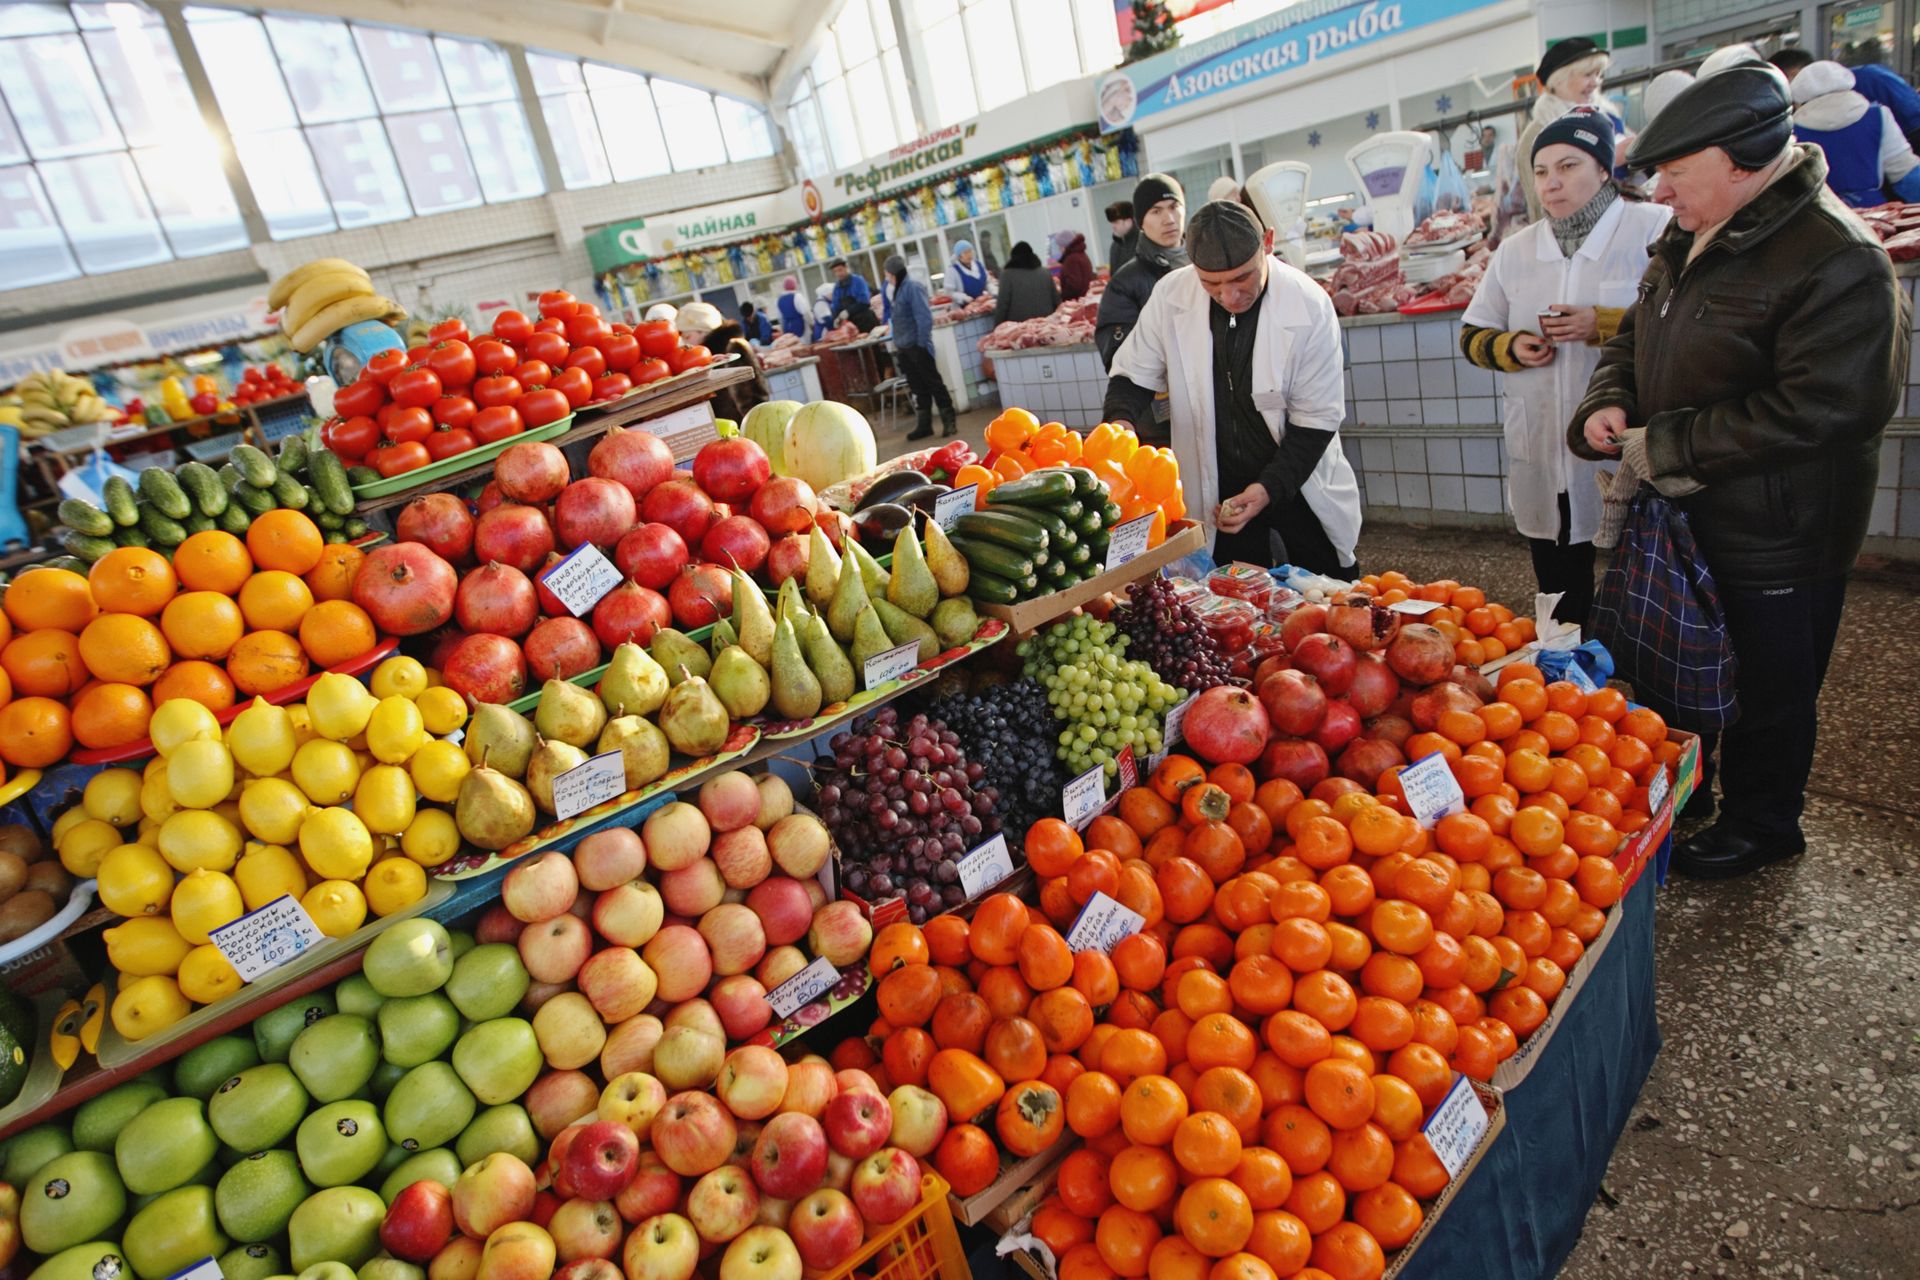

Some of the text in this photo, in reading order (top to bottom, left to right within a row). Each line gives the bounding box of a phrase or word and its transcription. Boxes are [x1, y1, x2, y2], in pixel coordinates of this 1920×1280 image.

[1164, 2, 1401, 103] Азовская рыба
[678, 212, 756, 239] ЧАЙНАЯ
[228, 915, 301, 958] ароматные
[235, 936, 279, 964] сочные
